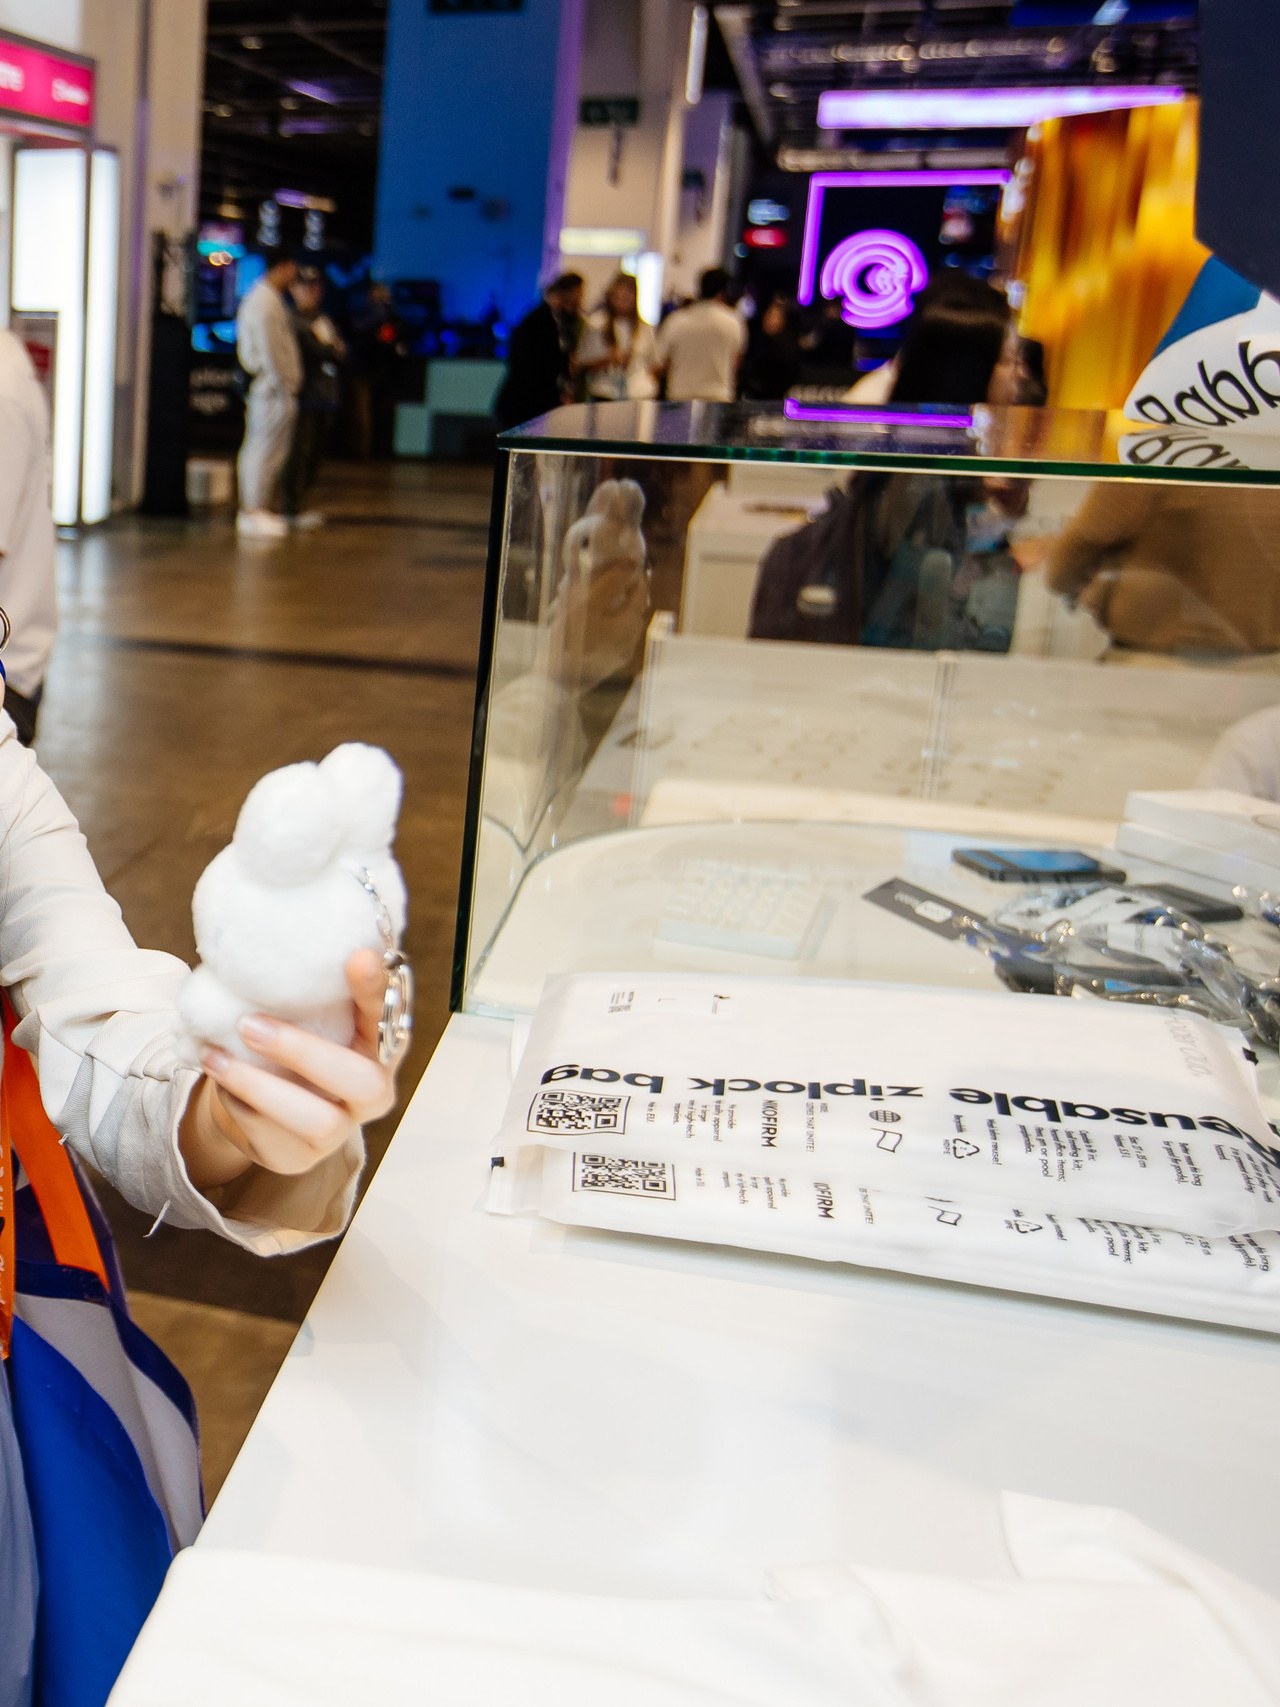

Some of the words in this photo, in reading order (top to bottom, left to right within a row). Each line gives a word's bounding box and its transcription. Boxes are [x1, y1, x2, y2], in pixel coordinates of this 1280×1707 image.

[540, 1064, 664, 1094] bag
[687, 1078, 923, 1101] ziplock
[712, 1117, 723, 1142] apparel
[991, 1142, 1003, 1166] reuse!
[1039, 1159, 1054, 1178] pool
[1057, 1159, 1067, 1182] items;
[1104, 1237, 1120, 1257] pool
